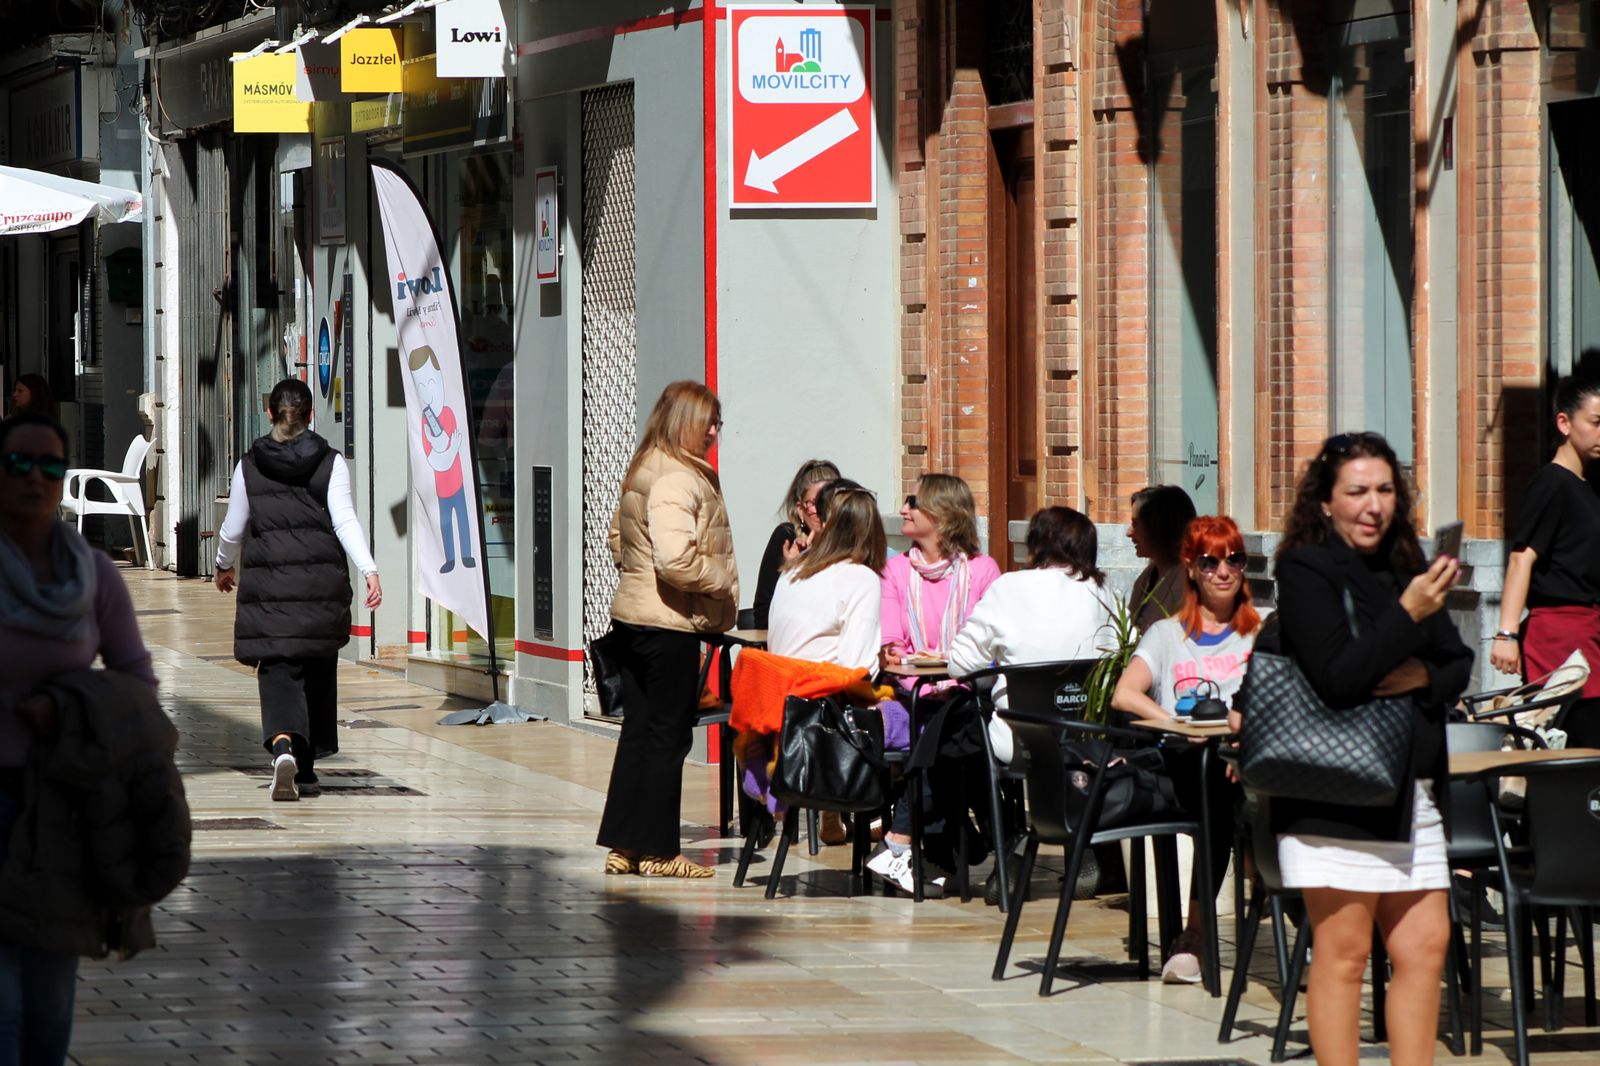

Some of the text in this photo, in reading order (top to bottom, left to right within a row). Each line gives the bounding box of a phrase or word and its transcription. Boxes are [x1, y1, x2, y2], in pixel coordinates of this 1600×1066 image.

[450, 26, 501, 43] Lowi
[350, 53, 396, 65] Jazztel
[752, 74, 851, 89] MOVILCITY
[1055, 693, 1089, 704] BARCO
